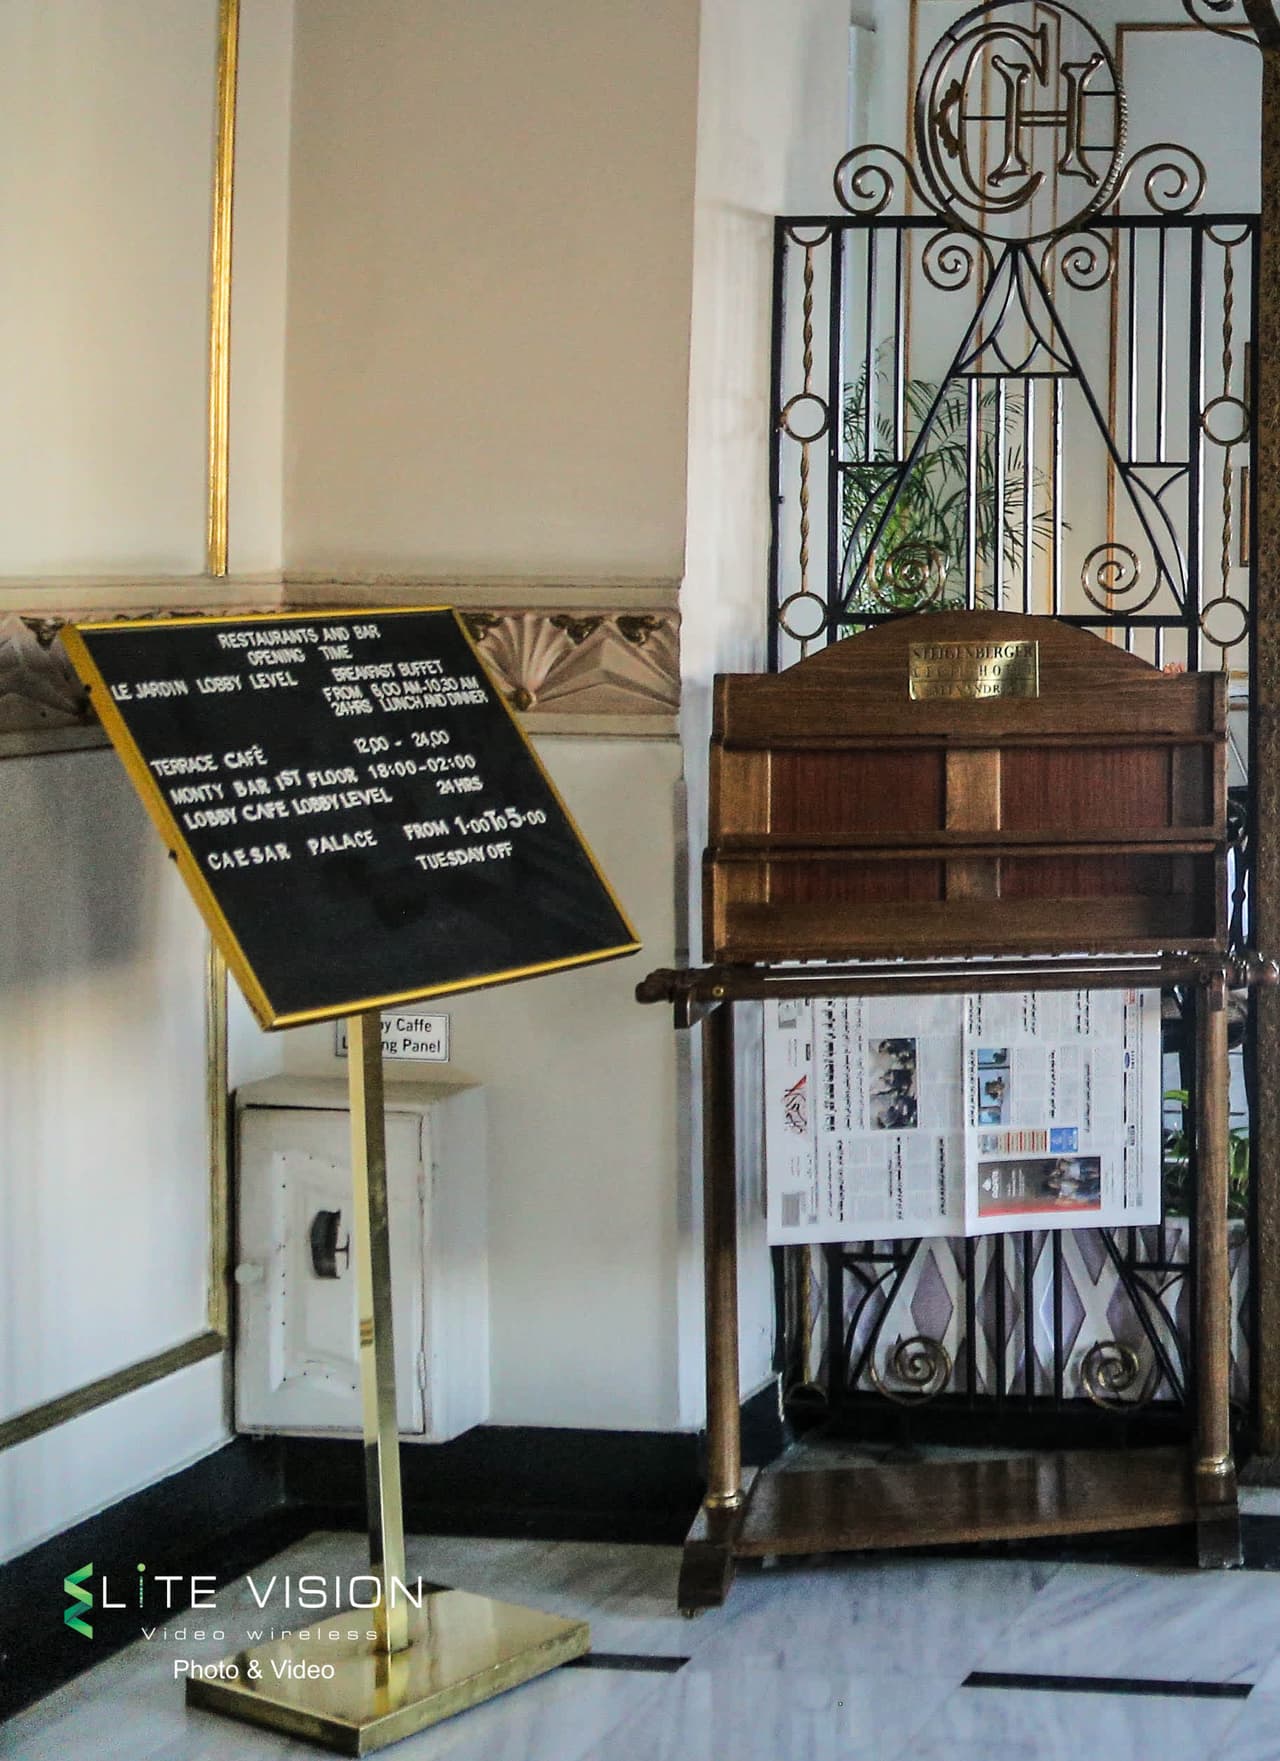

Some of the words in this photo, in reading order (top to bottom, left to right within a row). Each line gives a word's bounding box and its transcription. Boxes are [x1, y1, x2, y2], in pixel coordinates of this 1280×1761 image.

[217, 627, 319, 649] RESTAURANTS
[323, 626, 350, 642] AND
[352, 624, 381, 641] BAR
[247, 648, 306, 667] OPENING
[318, 644, 353, 661] TIME
[331, 662, 396, 682] BREAKFAST
[397, 659, 444, 678] BUFFET
[111, 682, 133, 701] LE
[135, 679, 189, 699] JARDIN
[196, 674, 243, 694] LOBBY
[249, 671, 299, 690] LEVEL
[322, 684, 363, 702] FROM
[459, 674, 479, 691] AM
[379, 696, 424, 712] LUNCH
[423, 692, 447, 709] AND
[446, 689, 489, 706] DINNER
[150, 754, 219, 777] TERRACE
[169, 782, 225, 806] MONTY
[232, 777, 271, 799] BAR
[306, 767, 359, 789] FLOOR
[183, 806, 238, 831] LOBBY
[242, 799, 290, 823] CAFE
[292, 792, 341, 816] LOBBY
[340, 787, 393, 809] LEVEL
[402, 818, 450, 841] FROM
[207, 842, 292, 871] CAESAR
[306, 829, 378, 856] PALACE
[415, 844, 486, 871] TUESDAY
[486, 841, 513, 859] OFF
[396, 1018, 432, 1033] Caffe
[402, 1038, 441, 1053] Panel
